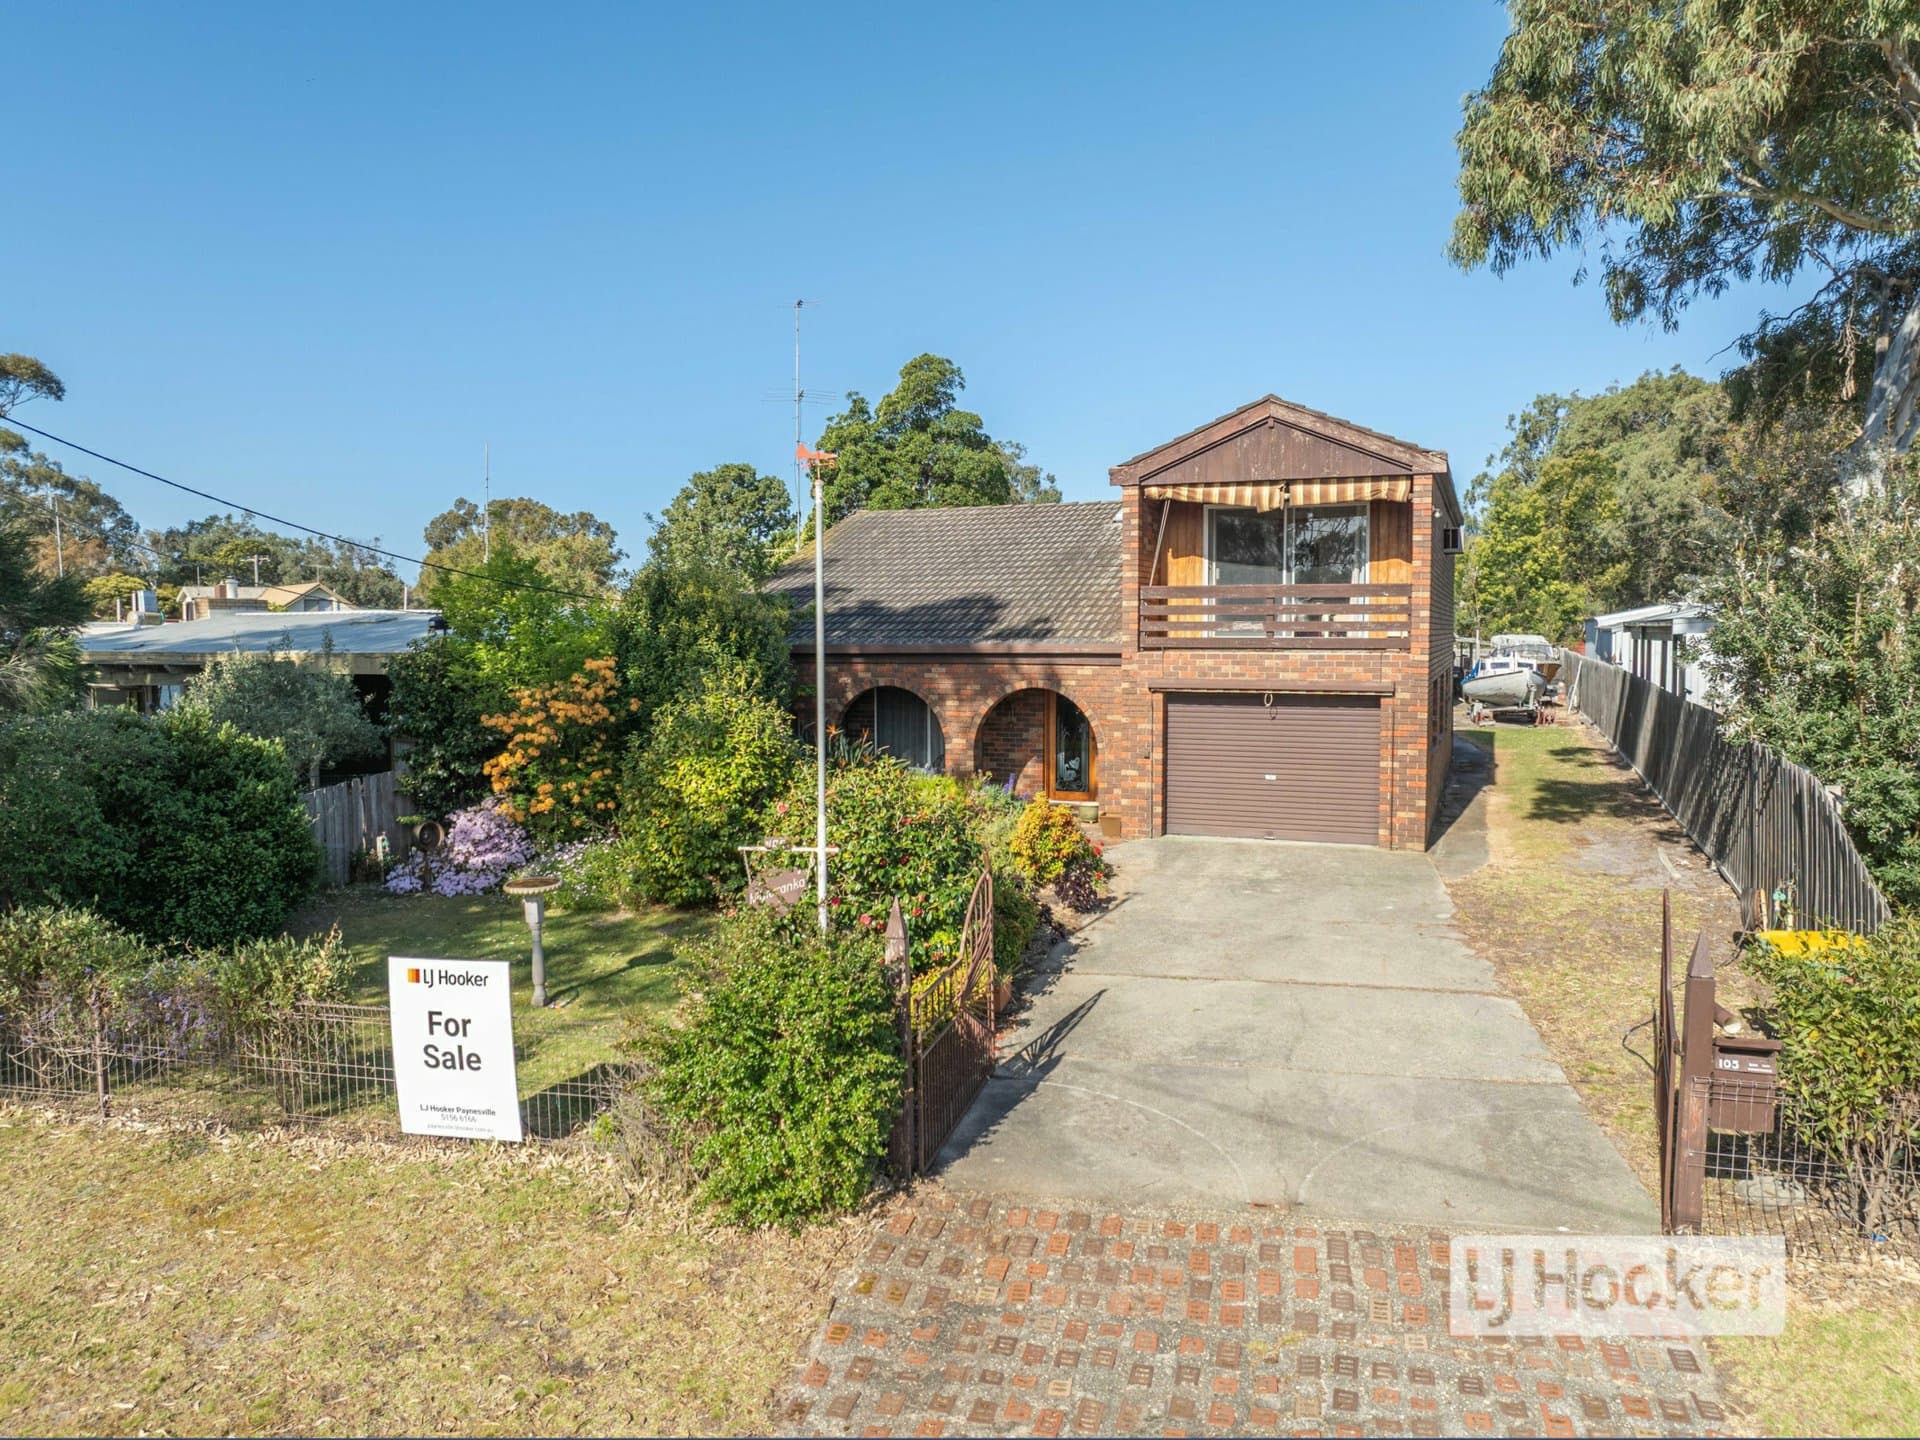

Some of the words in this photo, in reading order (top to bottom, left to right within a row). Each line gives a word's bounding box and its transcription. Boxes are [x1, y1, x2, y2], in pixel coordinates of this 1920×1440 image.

[423, 968, 434, 988] LJ
[438, 969, 489, 987] Hooker
[427, 1010, 472, 1037] For
[423, 1043, 482, 1071] Sale
[430, 1104, 455, 1113] Hooker
[456, 1106, 496, 1117] Paynesville
